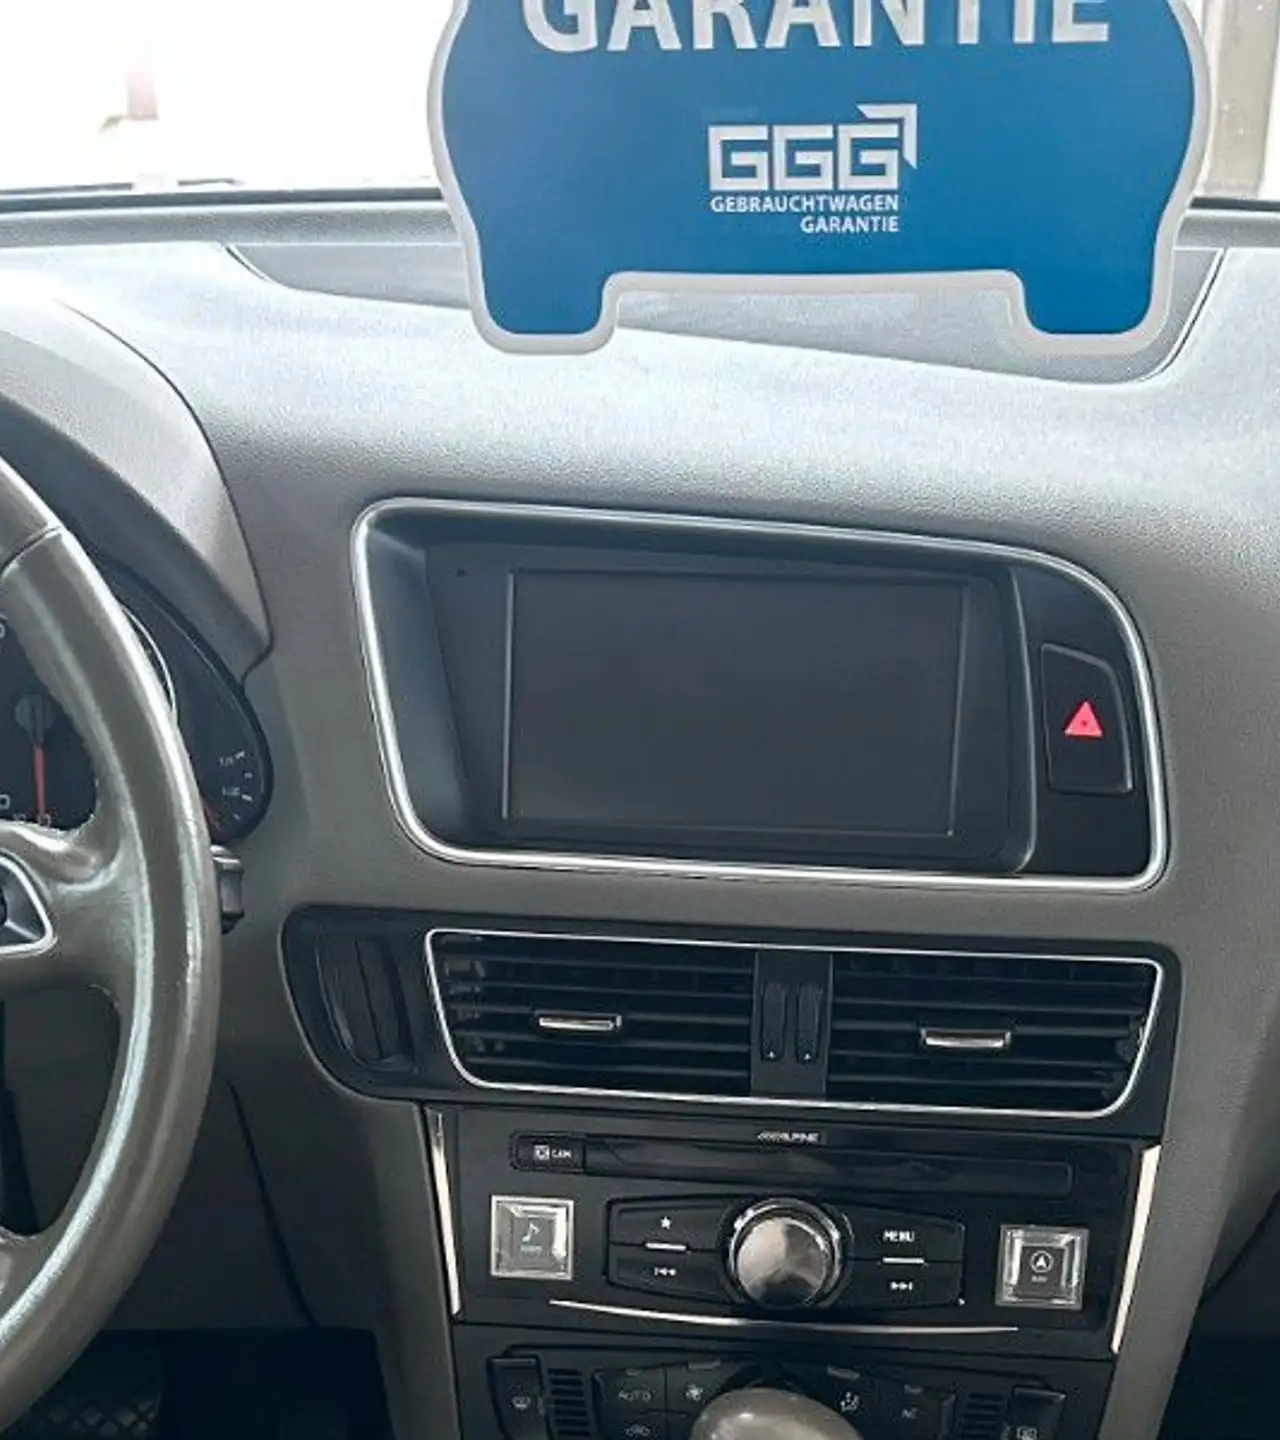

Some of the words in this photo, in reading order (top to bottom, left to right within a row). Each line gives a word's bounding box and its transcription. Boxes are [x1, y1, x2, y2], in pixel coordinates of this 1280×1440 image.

[708, 124, 899, 191] GGG
[709, 195, 899, 212] GEBRAUCHTWAGEN
[800, 216, 900, 233] GARANTIE
[551, 1149, 572, 1158] CAM
[883, 1230, 915, 1242] MENU
[619, 1390, 651, 1401] AUTO
